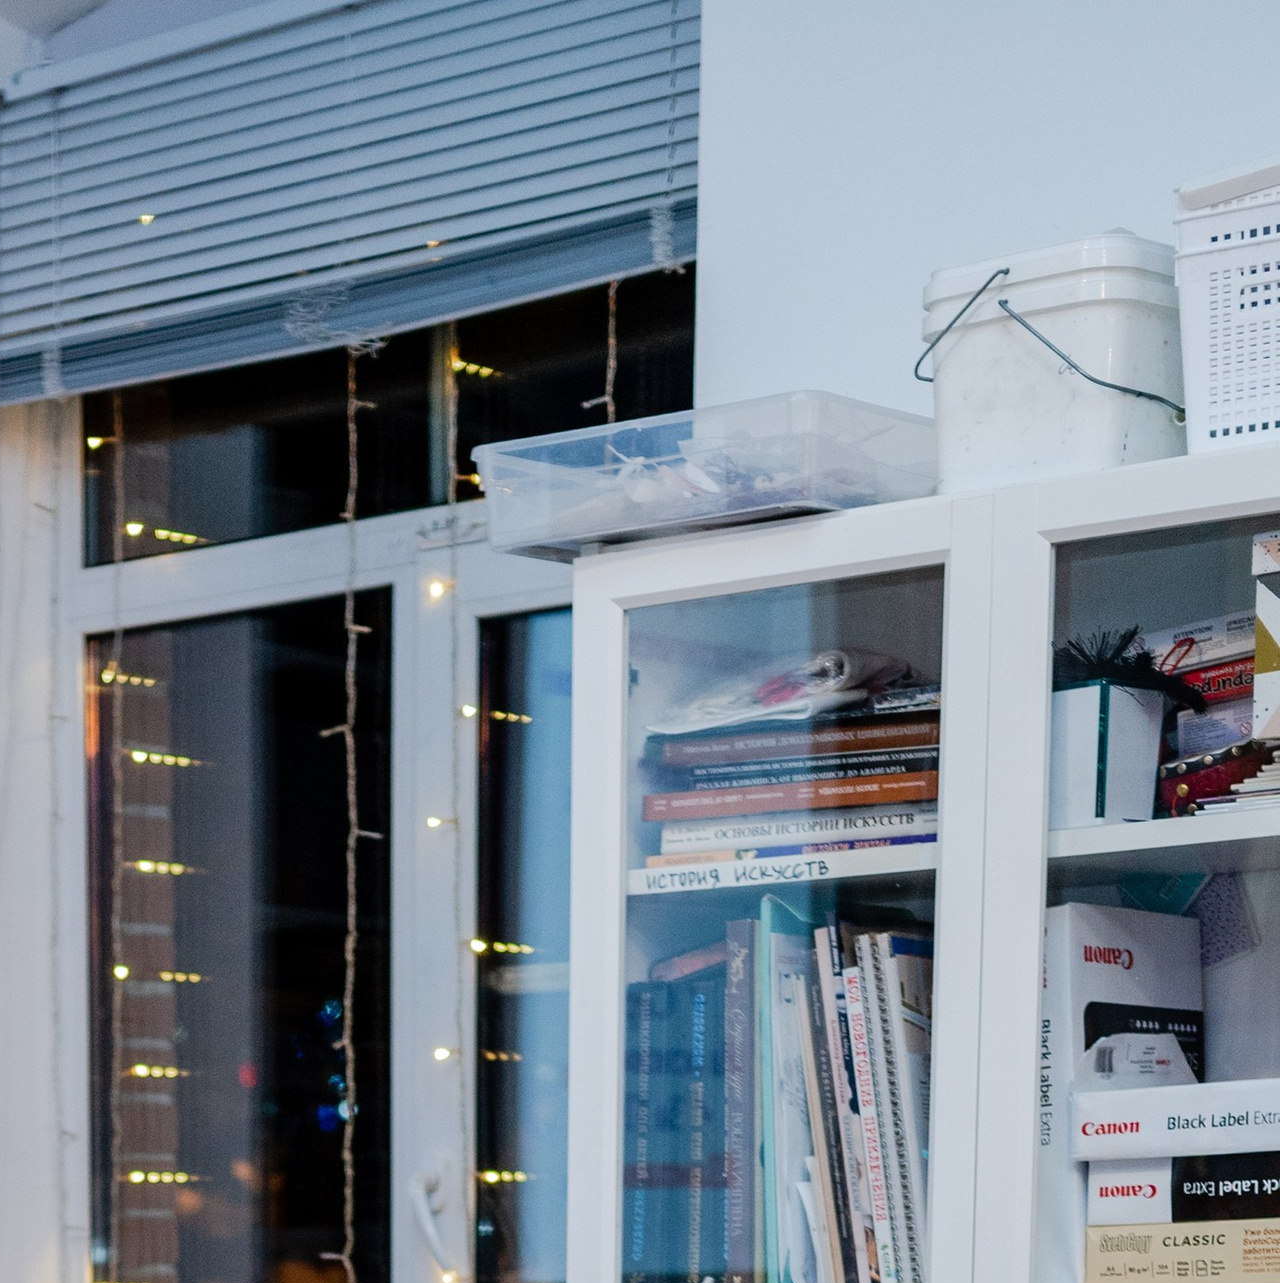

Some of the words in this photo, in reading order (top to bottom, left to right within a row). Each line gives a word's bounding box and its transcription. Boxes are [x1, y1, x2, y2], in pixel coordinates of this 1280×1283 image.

[714, 825, 772, 842] ОСНОВЫ
[776, 818, 839, 836] ИСТОРИИ
[842, 812, 916, 831] ИСКУССТВ
[646, 867, 721, 890] ИСТОРИЯ
[734, 860, 831, 883] ИСКУССТВ
[1083, 945, 1134, 970] Canon
[846, 976, 860, 1005] МОИ
[851, 1012, 873, 1107] НОВОГОДНИЕ
[1040, 1065, 1053, 1108] Label
[1040, 1111, 1053, 1147] Extra
[1081, 1121, 1140, 1137] Canon
[1167, 1114, 1207, 1131] Black
[1211, 1111, 1249, 1128] Label
[864, 1116, 888, 1222] ПРИКЛЮЧЕНИЯ
[1099, 1184, 1157, 1199] Canon
[1183, 1181, 1216, 1197] Extra
[1219, 1179, 1259, 1197] Label
[1162, 1234, 1227, 1248] CLASSIC
